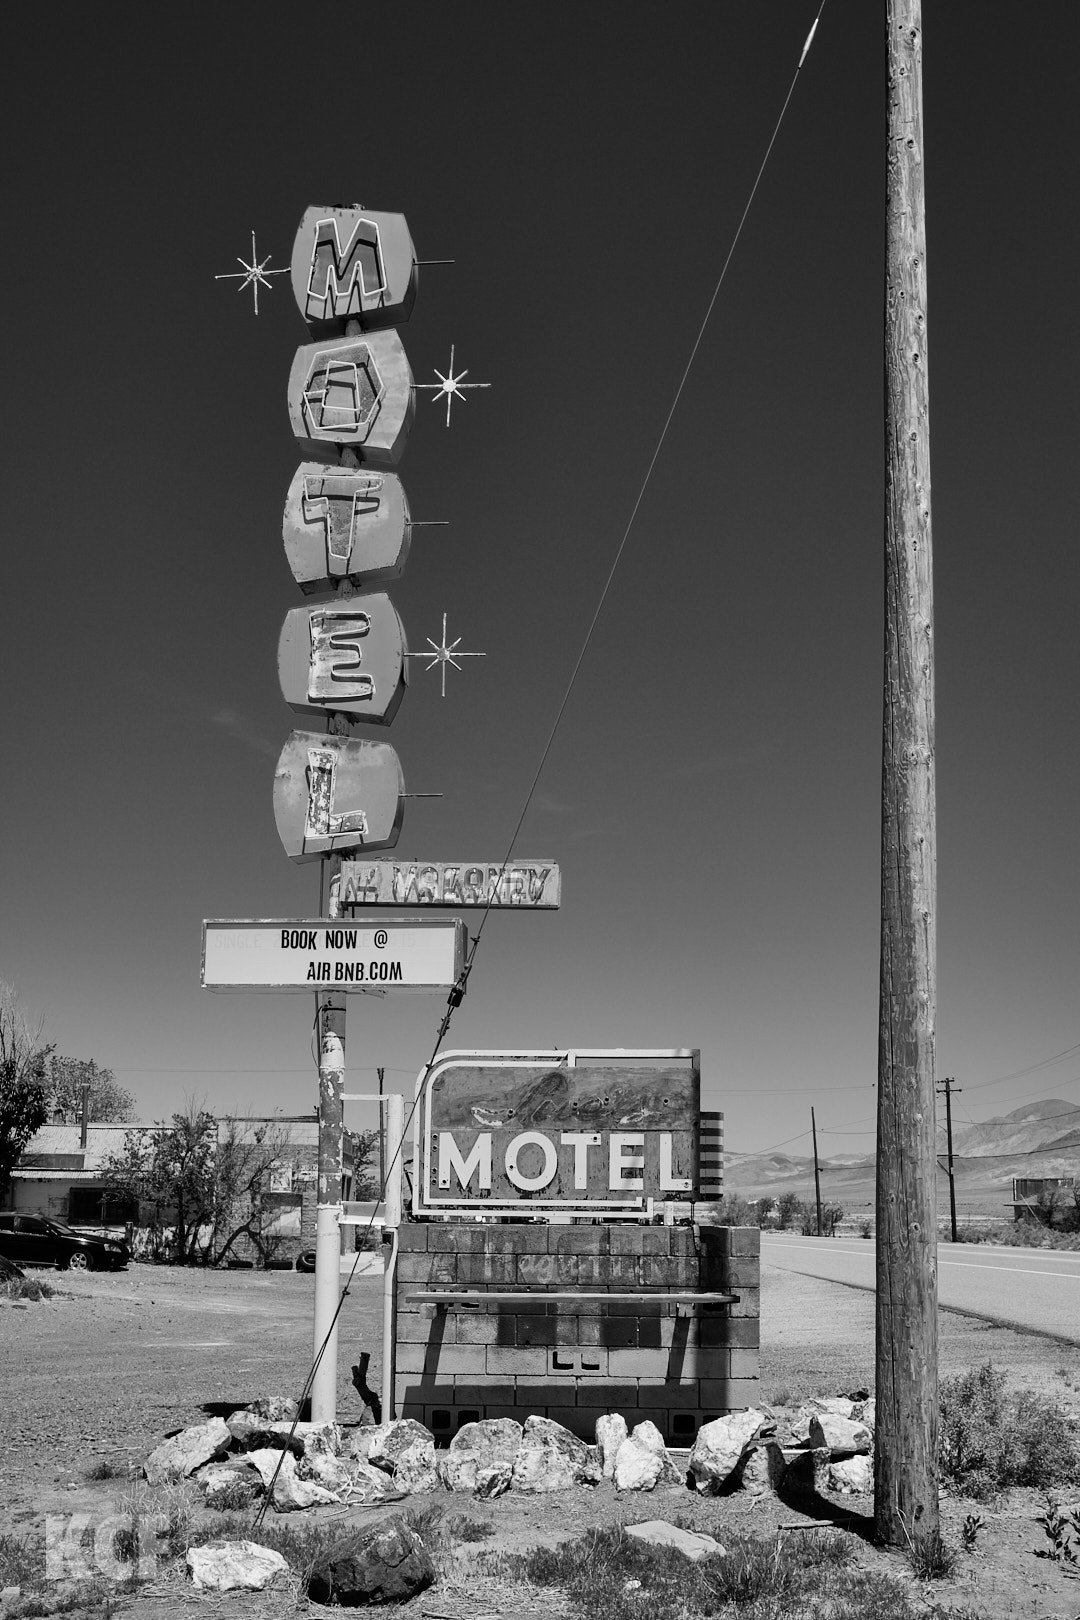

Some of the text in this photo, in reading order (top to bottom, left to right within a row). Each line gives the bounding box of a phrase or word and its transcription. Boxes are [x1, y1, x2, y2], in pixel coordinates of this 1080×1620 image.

[303, 217, 387, 838] MOTEL
[281, 930, 317, 950] BOOK
[325, 930, 357, 949] NOW
[374, 929, 388, 949] @
[438, 1131, 693, 1191] MOTEL
